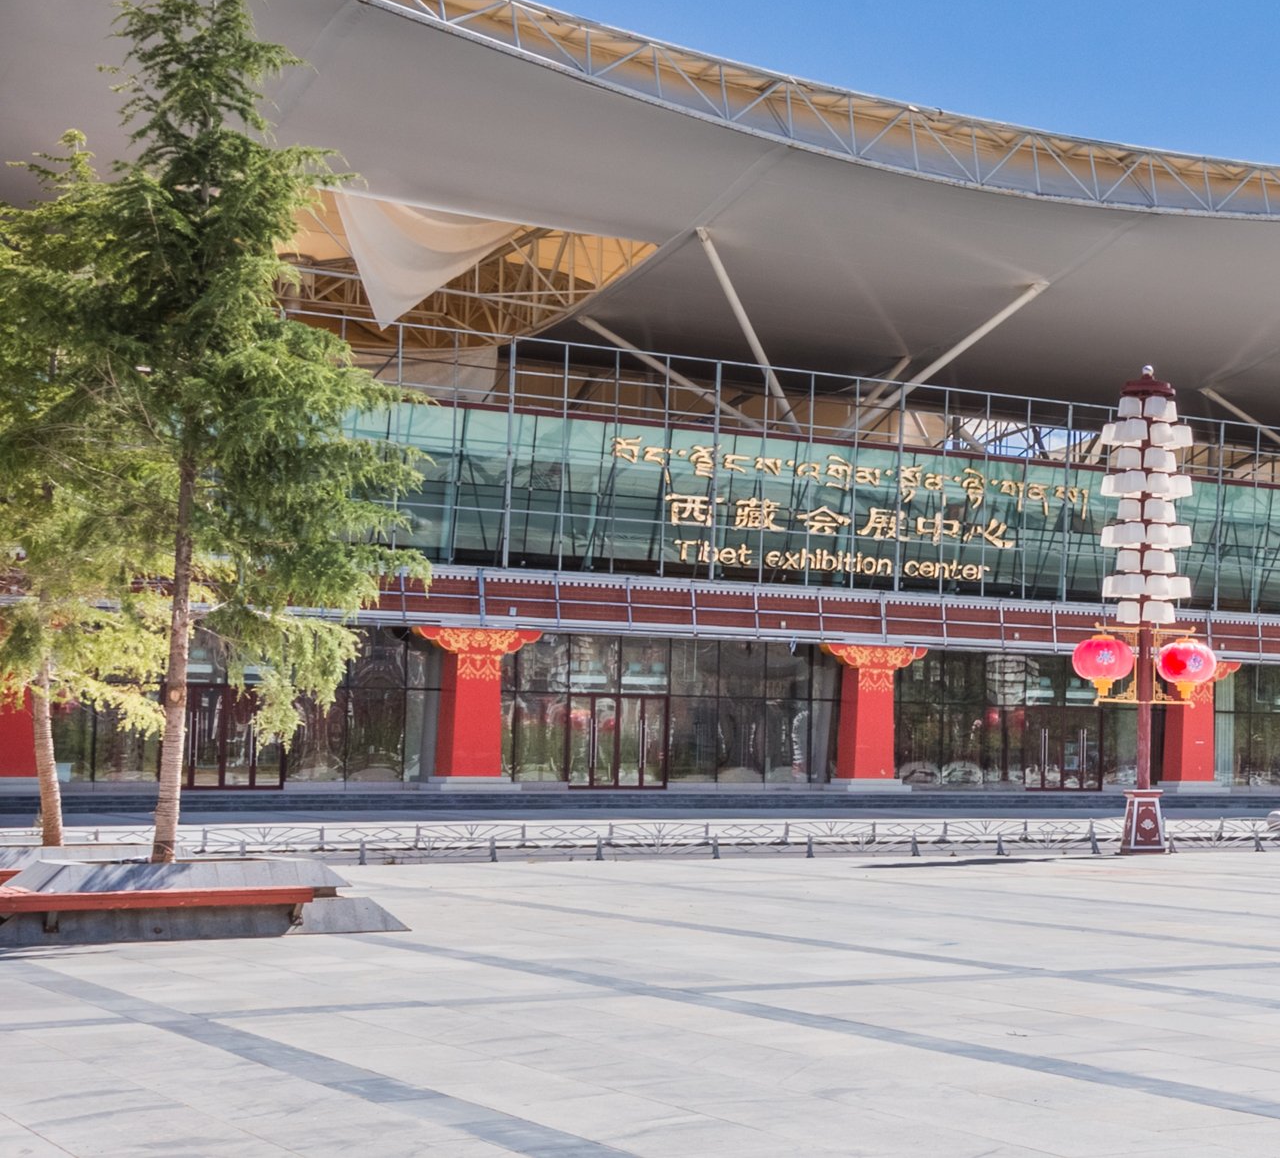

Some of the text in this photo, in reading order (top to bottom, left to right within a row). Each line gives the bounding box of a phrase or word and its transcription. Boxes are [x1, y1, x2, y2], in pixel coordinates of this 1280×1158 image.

[665, 493, 1016, 549] 西藏会展中心
[674, 539, 991, 580] Tibet exhibition center
